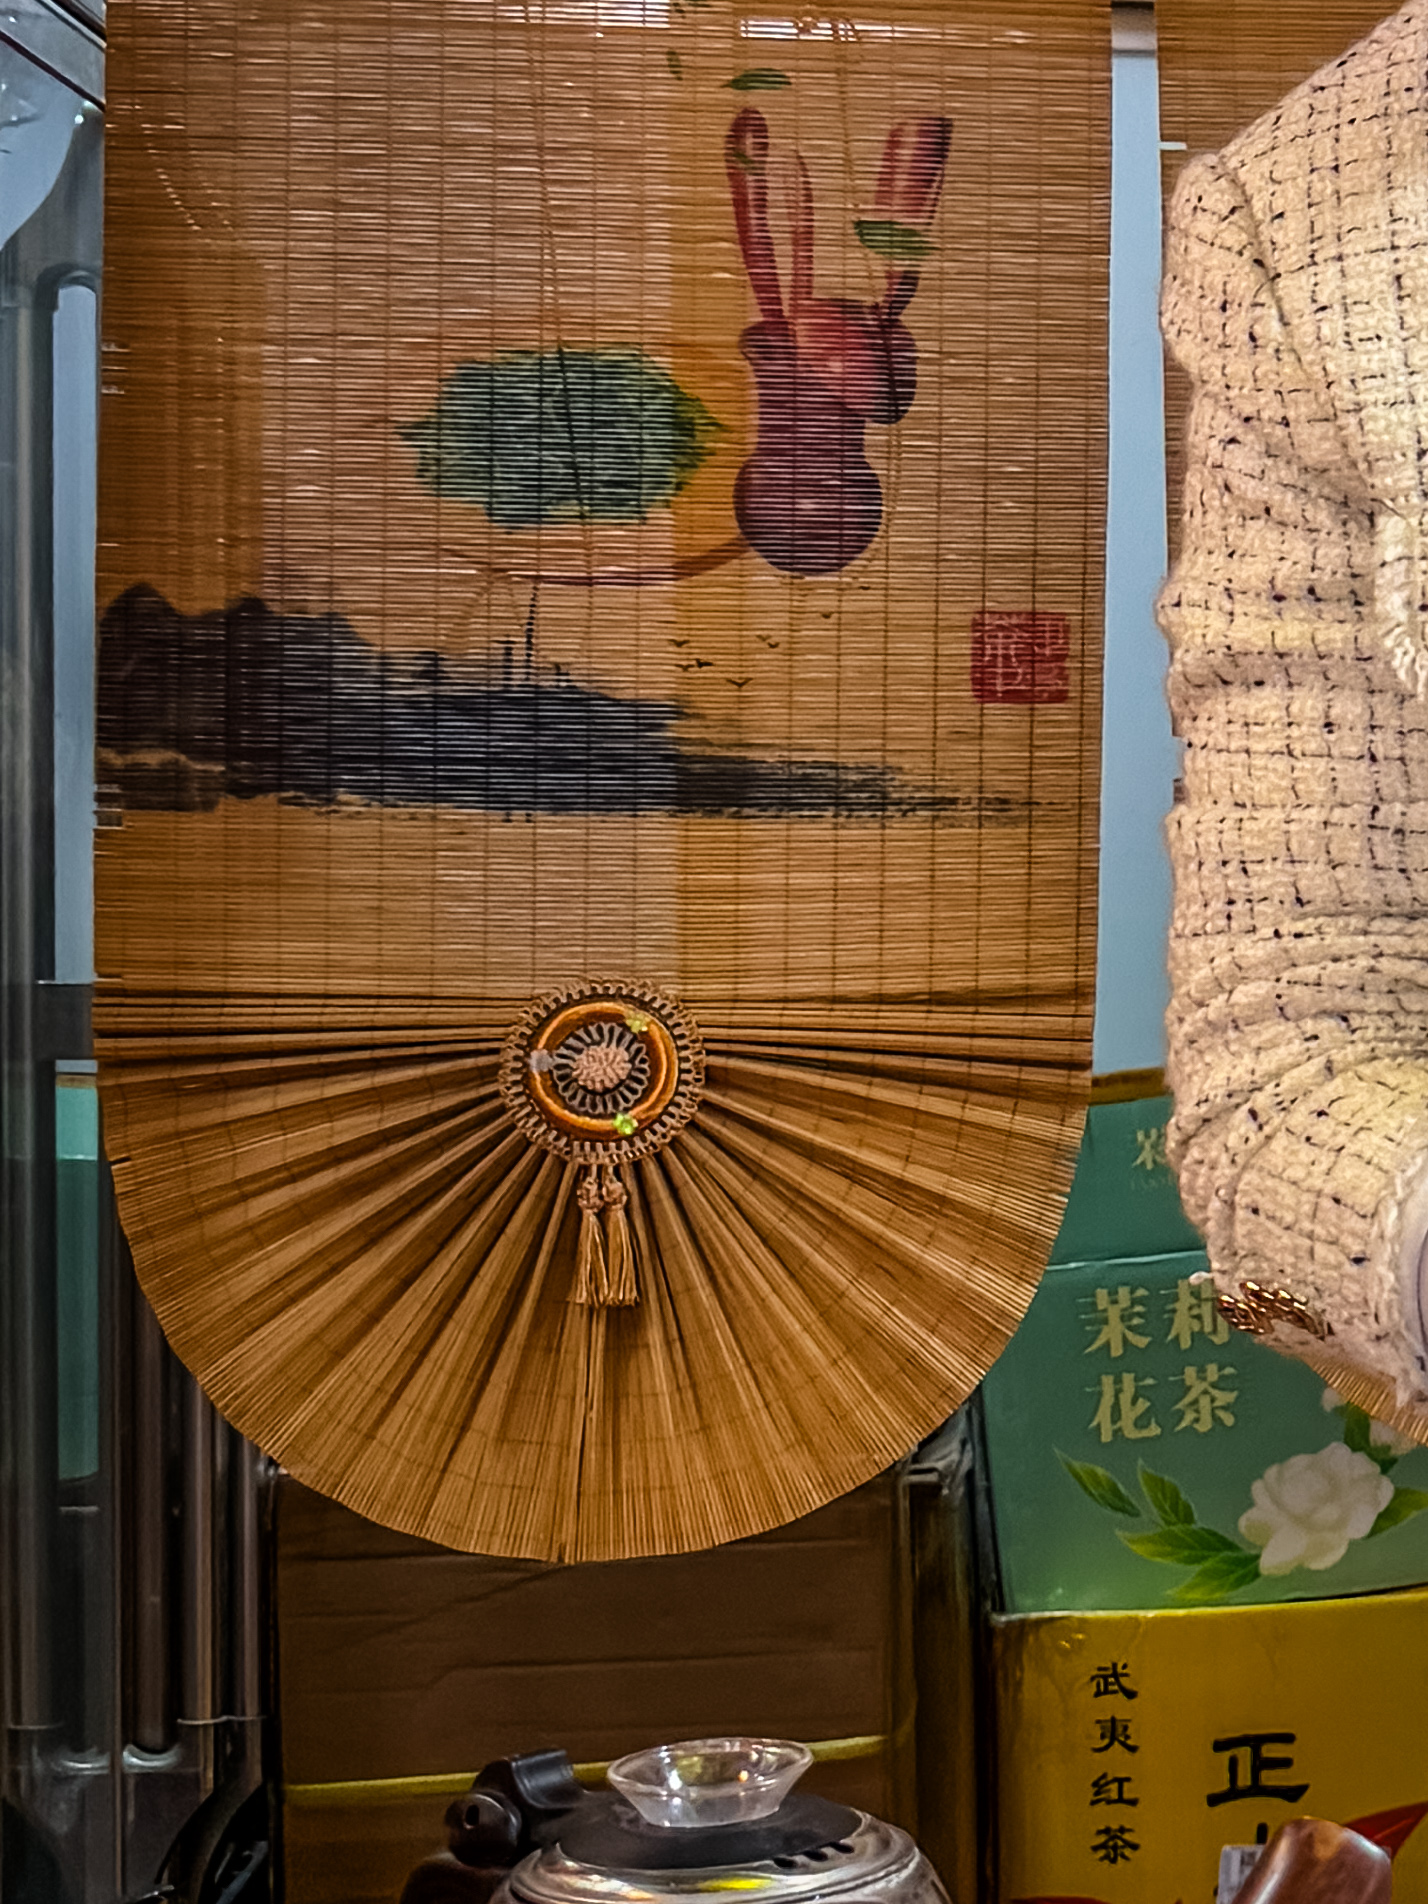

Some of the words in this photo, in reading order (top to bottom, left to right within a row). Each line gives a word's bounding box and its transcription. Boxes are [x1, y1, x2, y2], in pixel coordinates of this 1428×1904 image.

[1084, 1363, 1239, 1443] 花茶
[1089, 1661, 1141, 1865] 武夷红茶
